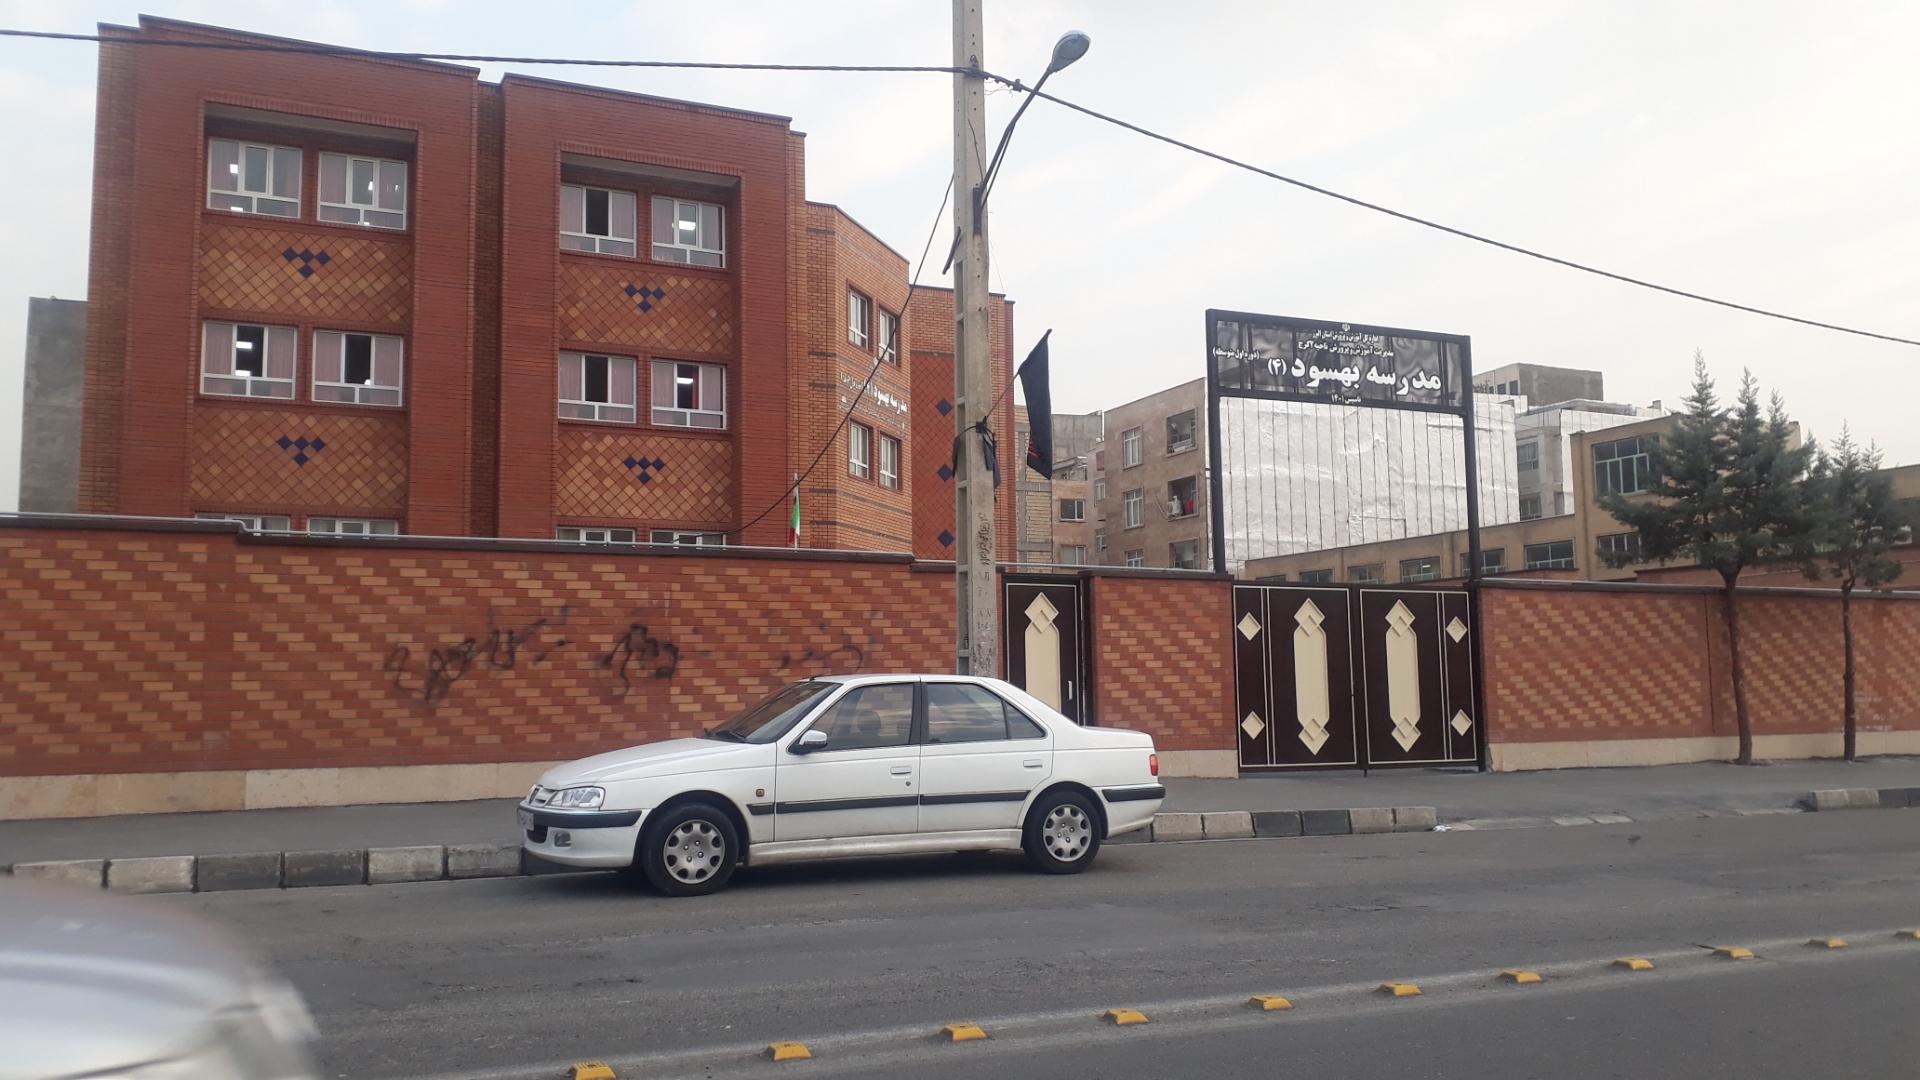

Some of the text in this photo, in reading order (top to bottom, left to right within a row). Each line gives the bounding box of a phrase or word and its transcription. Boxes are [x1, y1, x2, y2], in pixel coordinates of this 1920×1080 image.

[1322, 330, 1334, 339] استان
[1348, 332, 1362, 342] آموزش
[1298, 340, 1310, 350] کرج
[1314, 342, 1328, 350] ناحیه
[1235, 348, 1244, 359] اول
[1352, 345, 1373, 356] آموزش
[1374, 349, 1394, 358] مدیریت
[1267, 357, 1442, 395] مدرسه بهسود (۴)
